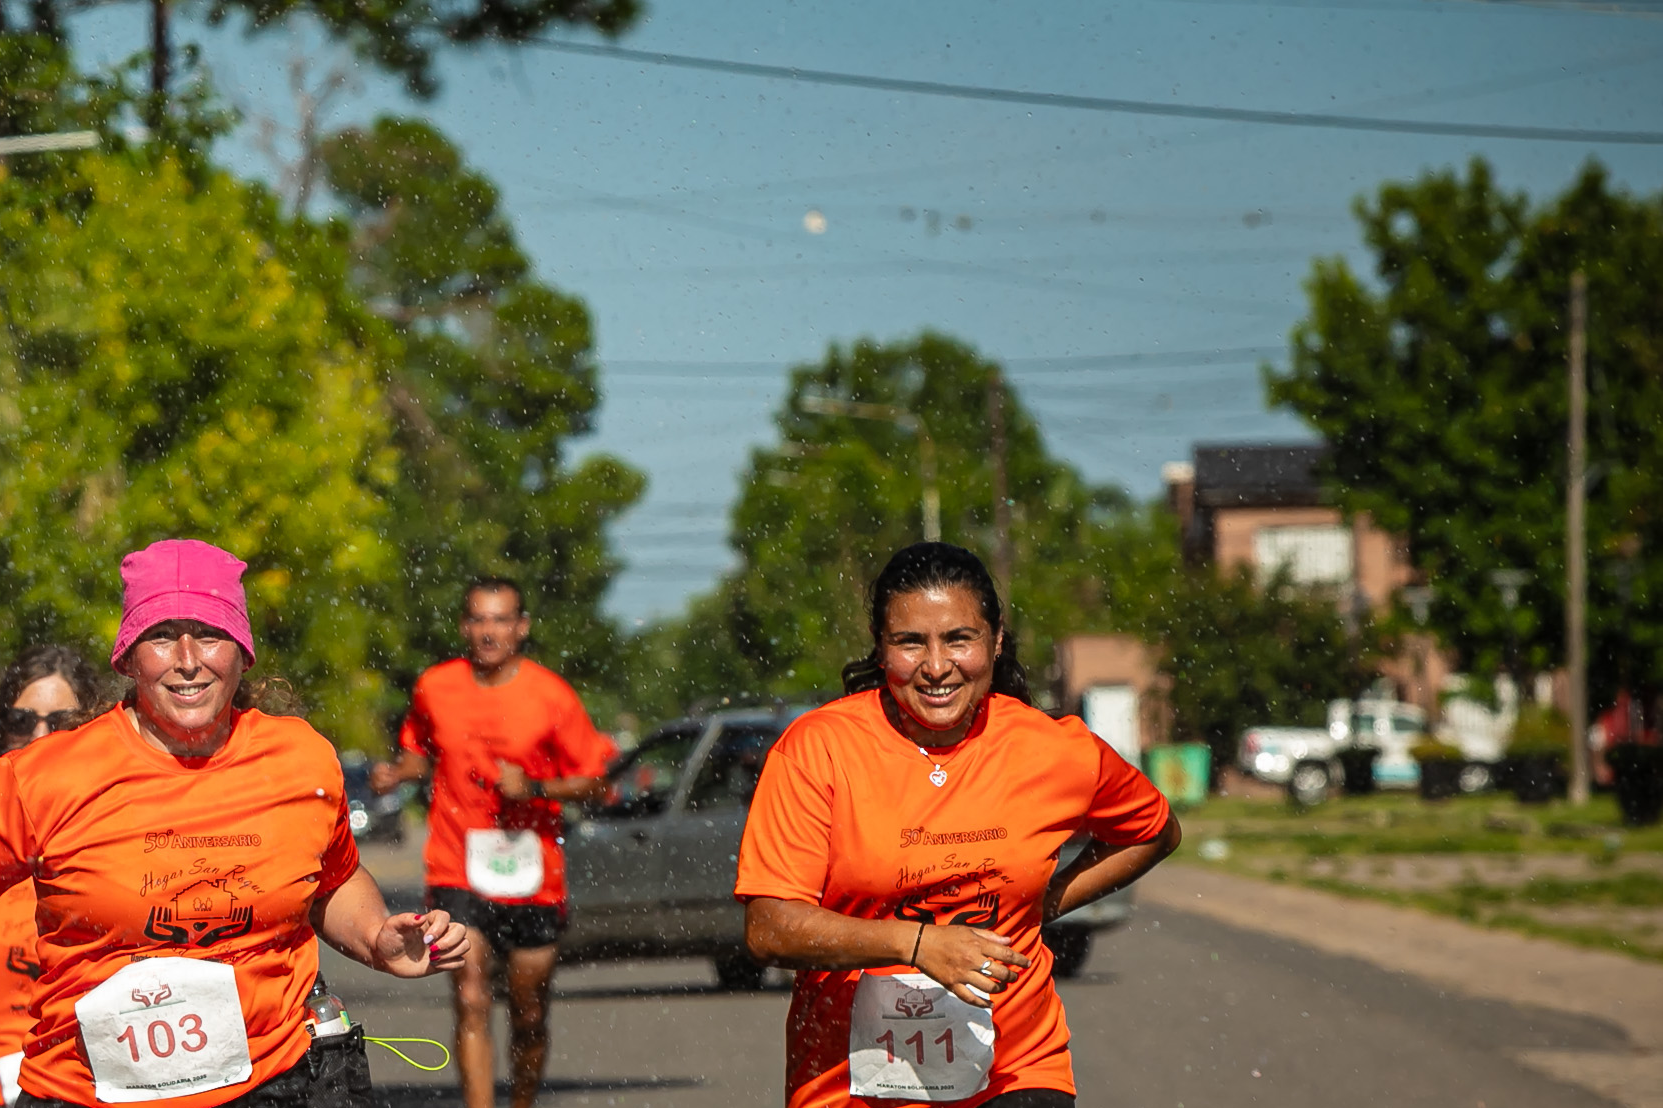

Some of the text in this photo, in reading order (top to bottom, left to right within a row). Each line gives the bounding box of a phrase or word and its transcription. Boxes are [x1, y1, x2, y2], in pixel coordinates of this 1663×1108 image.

[171, 834, 262, 849] ANIVERSARIO
[923, 827, 1008, 846] ANIVERSARIO
[139, 857, 265, 897] Hogar San Roque
[895, 865, 936, 890] Hogar
[941, 853, 971, 870] San
[117, 1013, 208, 1063] 103
[876, 1028, 954, 1065] 111
[157, 1078, 192, 1089] SOLIDARIA
